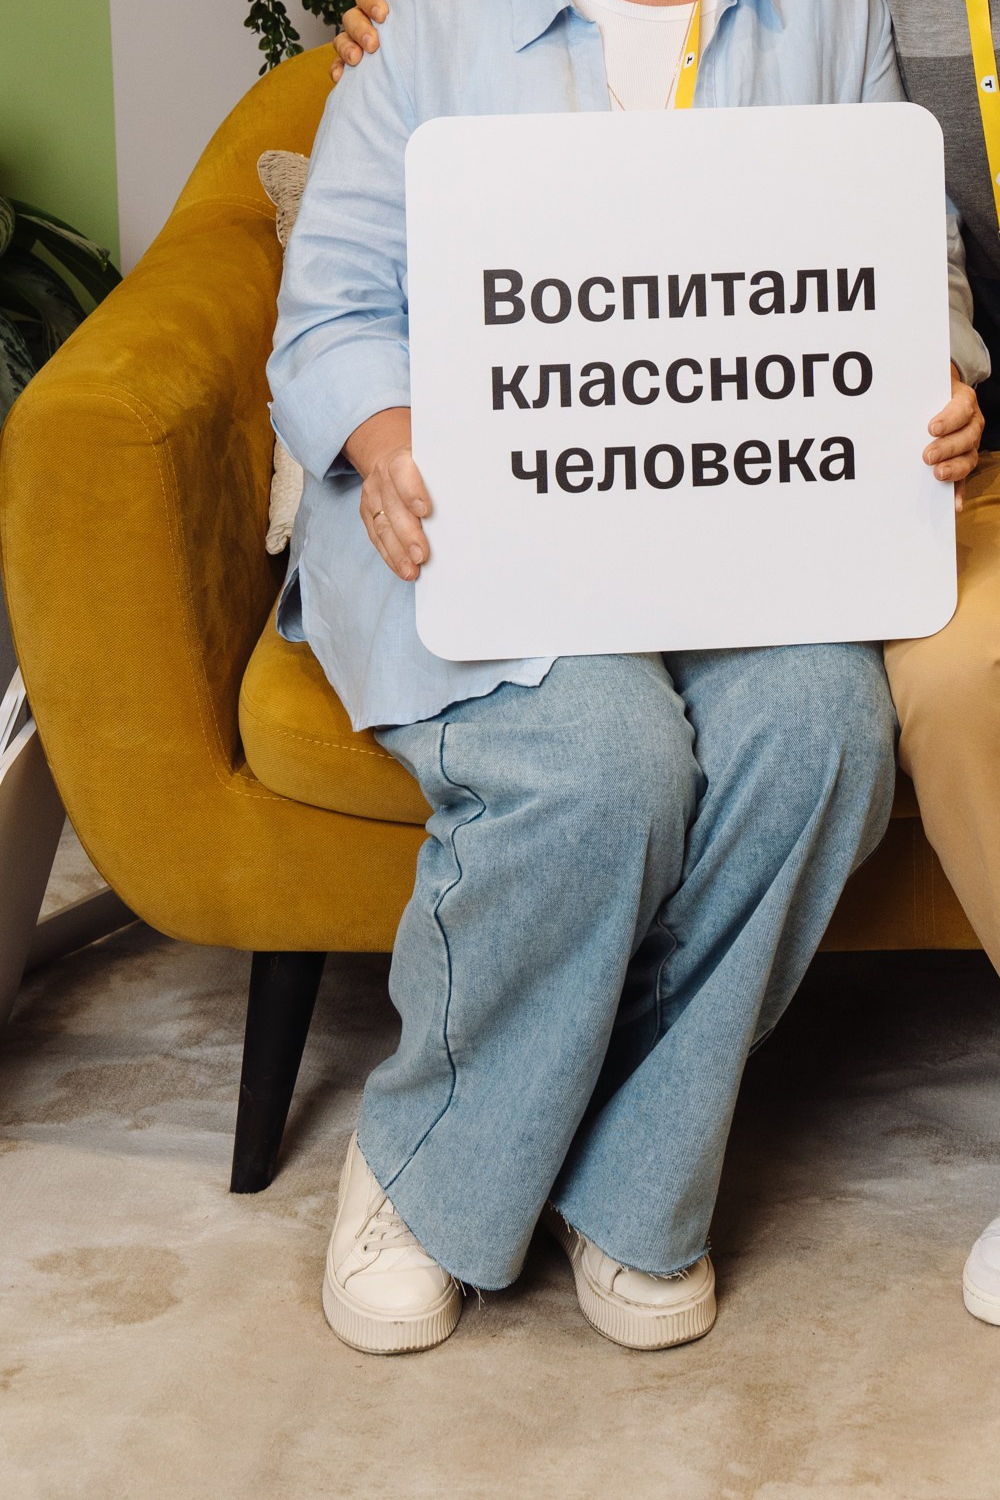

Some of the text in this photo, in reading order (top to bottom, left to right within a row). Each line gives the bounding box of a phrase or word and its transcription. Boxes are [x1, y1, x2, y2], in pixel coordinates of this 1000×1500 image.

[483, 267, 876, 326] Воспитали
[491, 351, 873, 411] классного
[511, 436, 856, 494] человека
